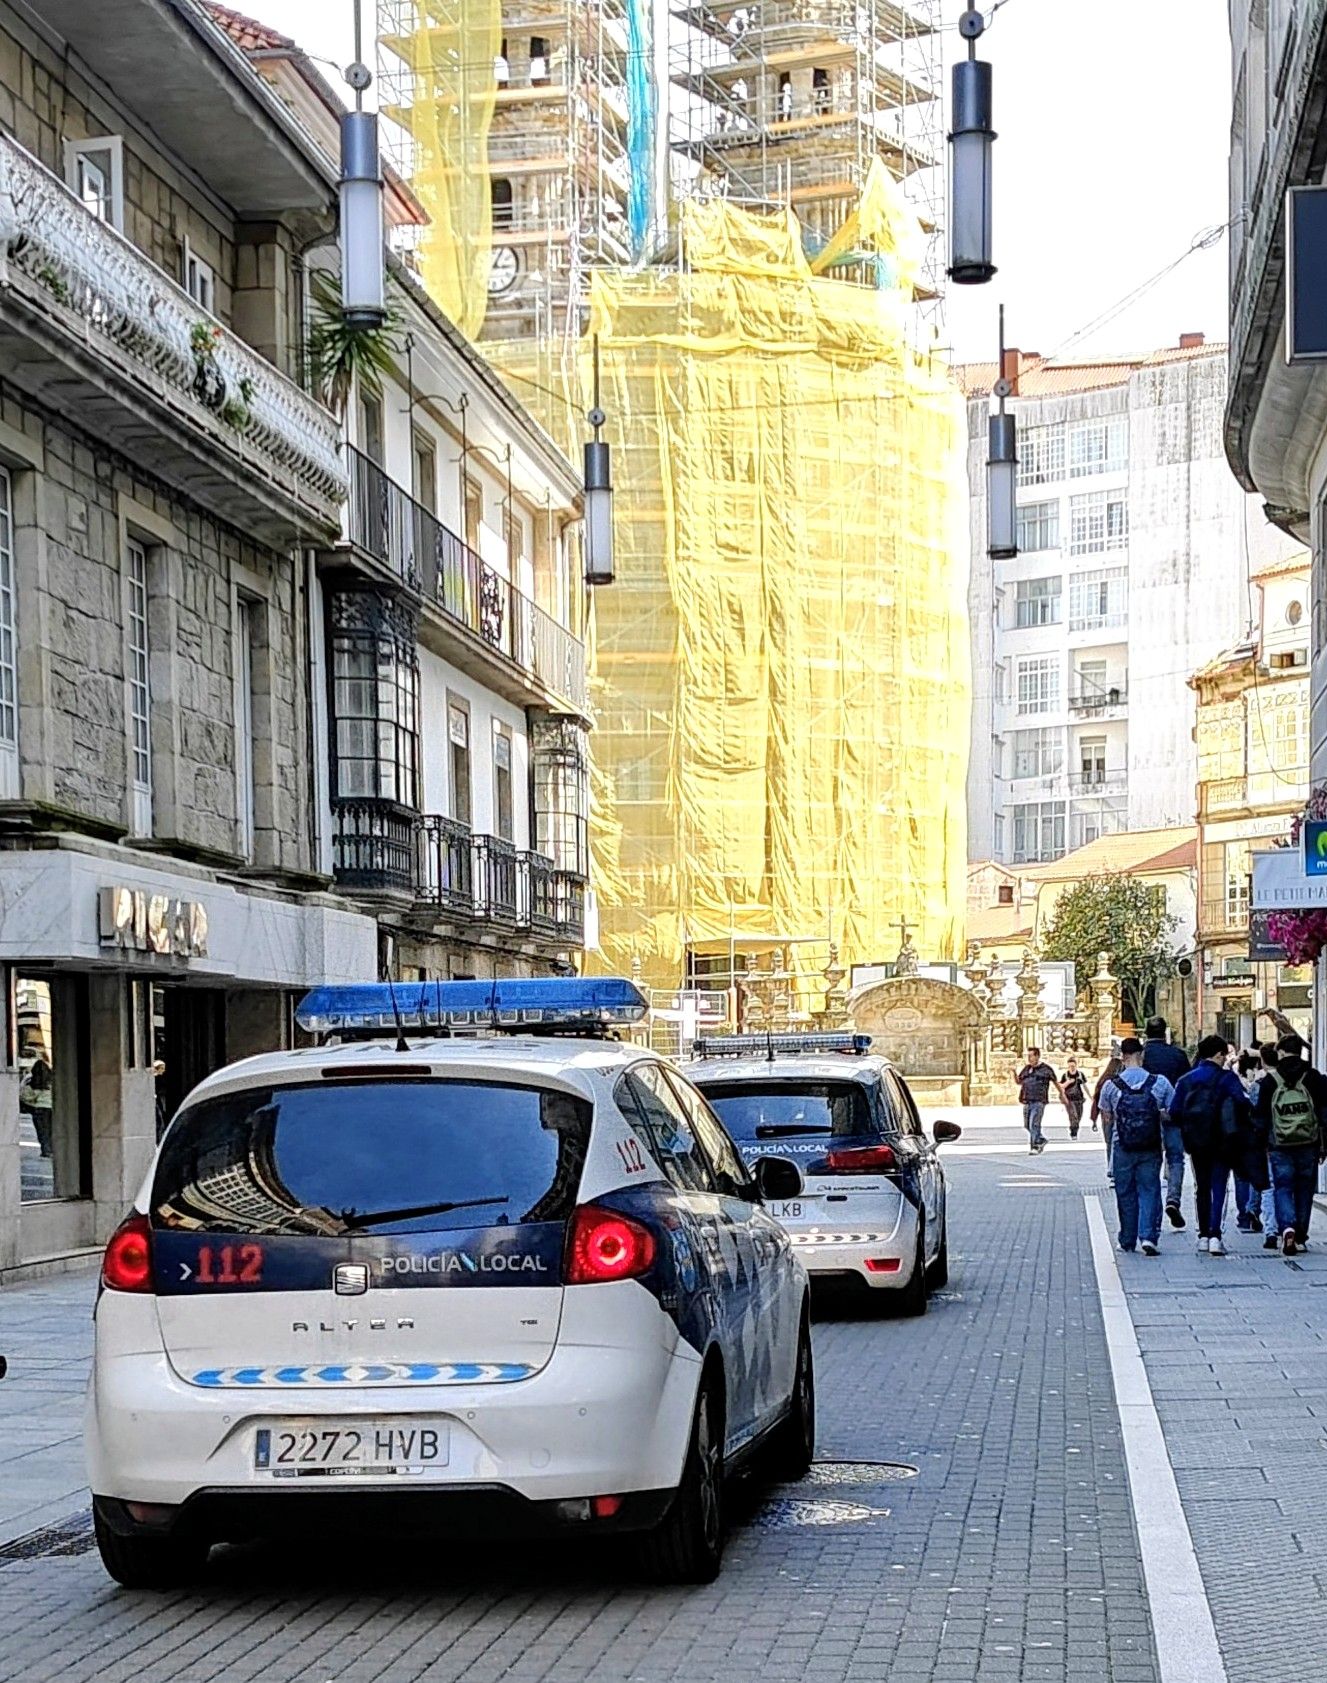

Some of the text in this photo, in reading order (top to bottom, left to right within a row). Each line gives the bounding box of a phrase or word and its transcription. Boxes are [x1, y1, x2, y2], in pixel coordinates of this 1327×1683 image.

[616, 1138, 647, 1174] 112
[742, 1144, 828, 1154] POLICÍA LOCAL
[772, 1202, 802, 1217] LKB
[195, 1243, 264, 1283] 112
[381, 1252, 547, 1273] POLICÍA LOCAL
[277, 1430, 439, 1463] 2272 HVB
